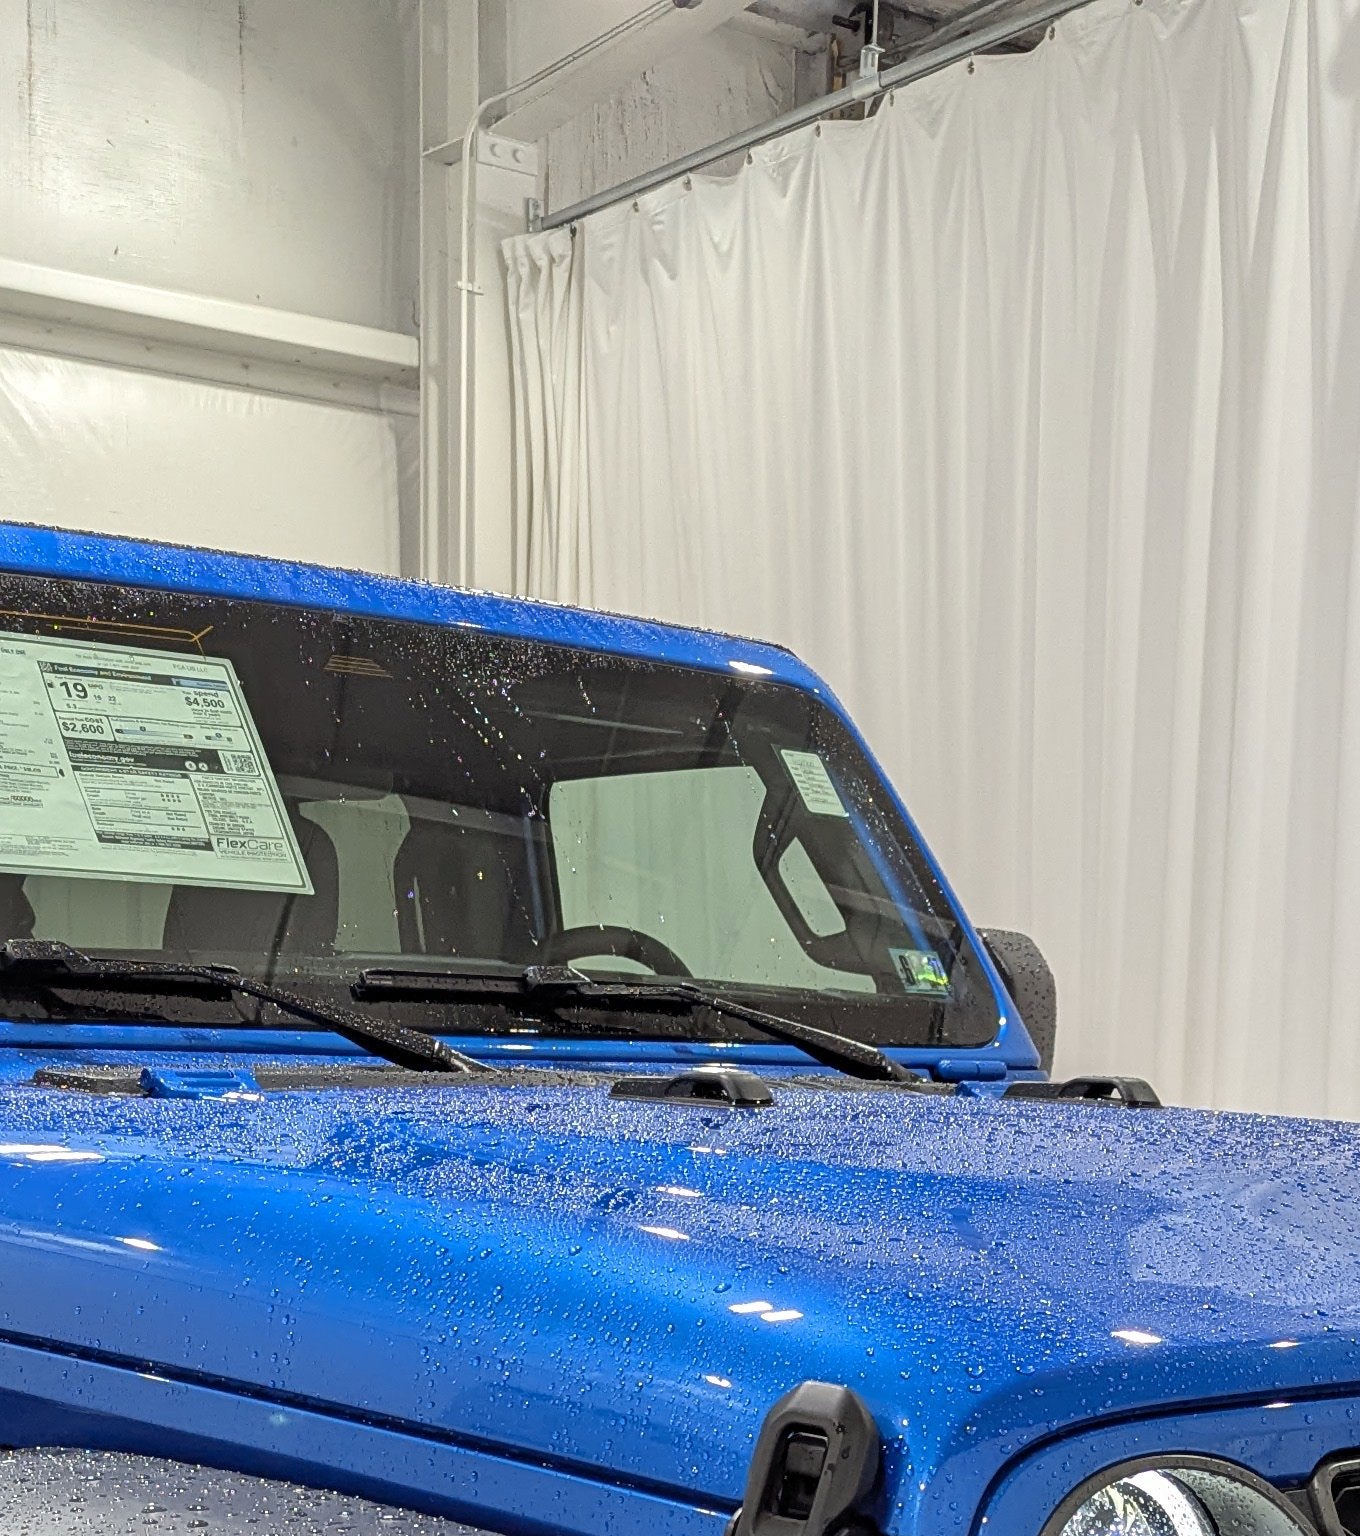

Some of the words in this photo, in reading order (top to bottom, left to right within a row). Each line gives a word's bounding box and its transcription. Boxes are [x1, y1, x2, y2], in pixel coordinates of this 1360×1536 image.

[59, 681, 89, 699] 19
[184, 696, 226, 709] $4,500
[61, 721, 106, 735] $2,600
[216, 837, 284, 851] FlexCare
